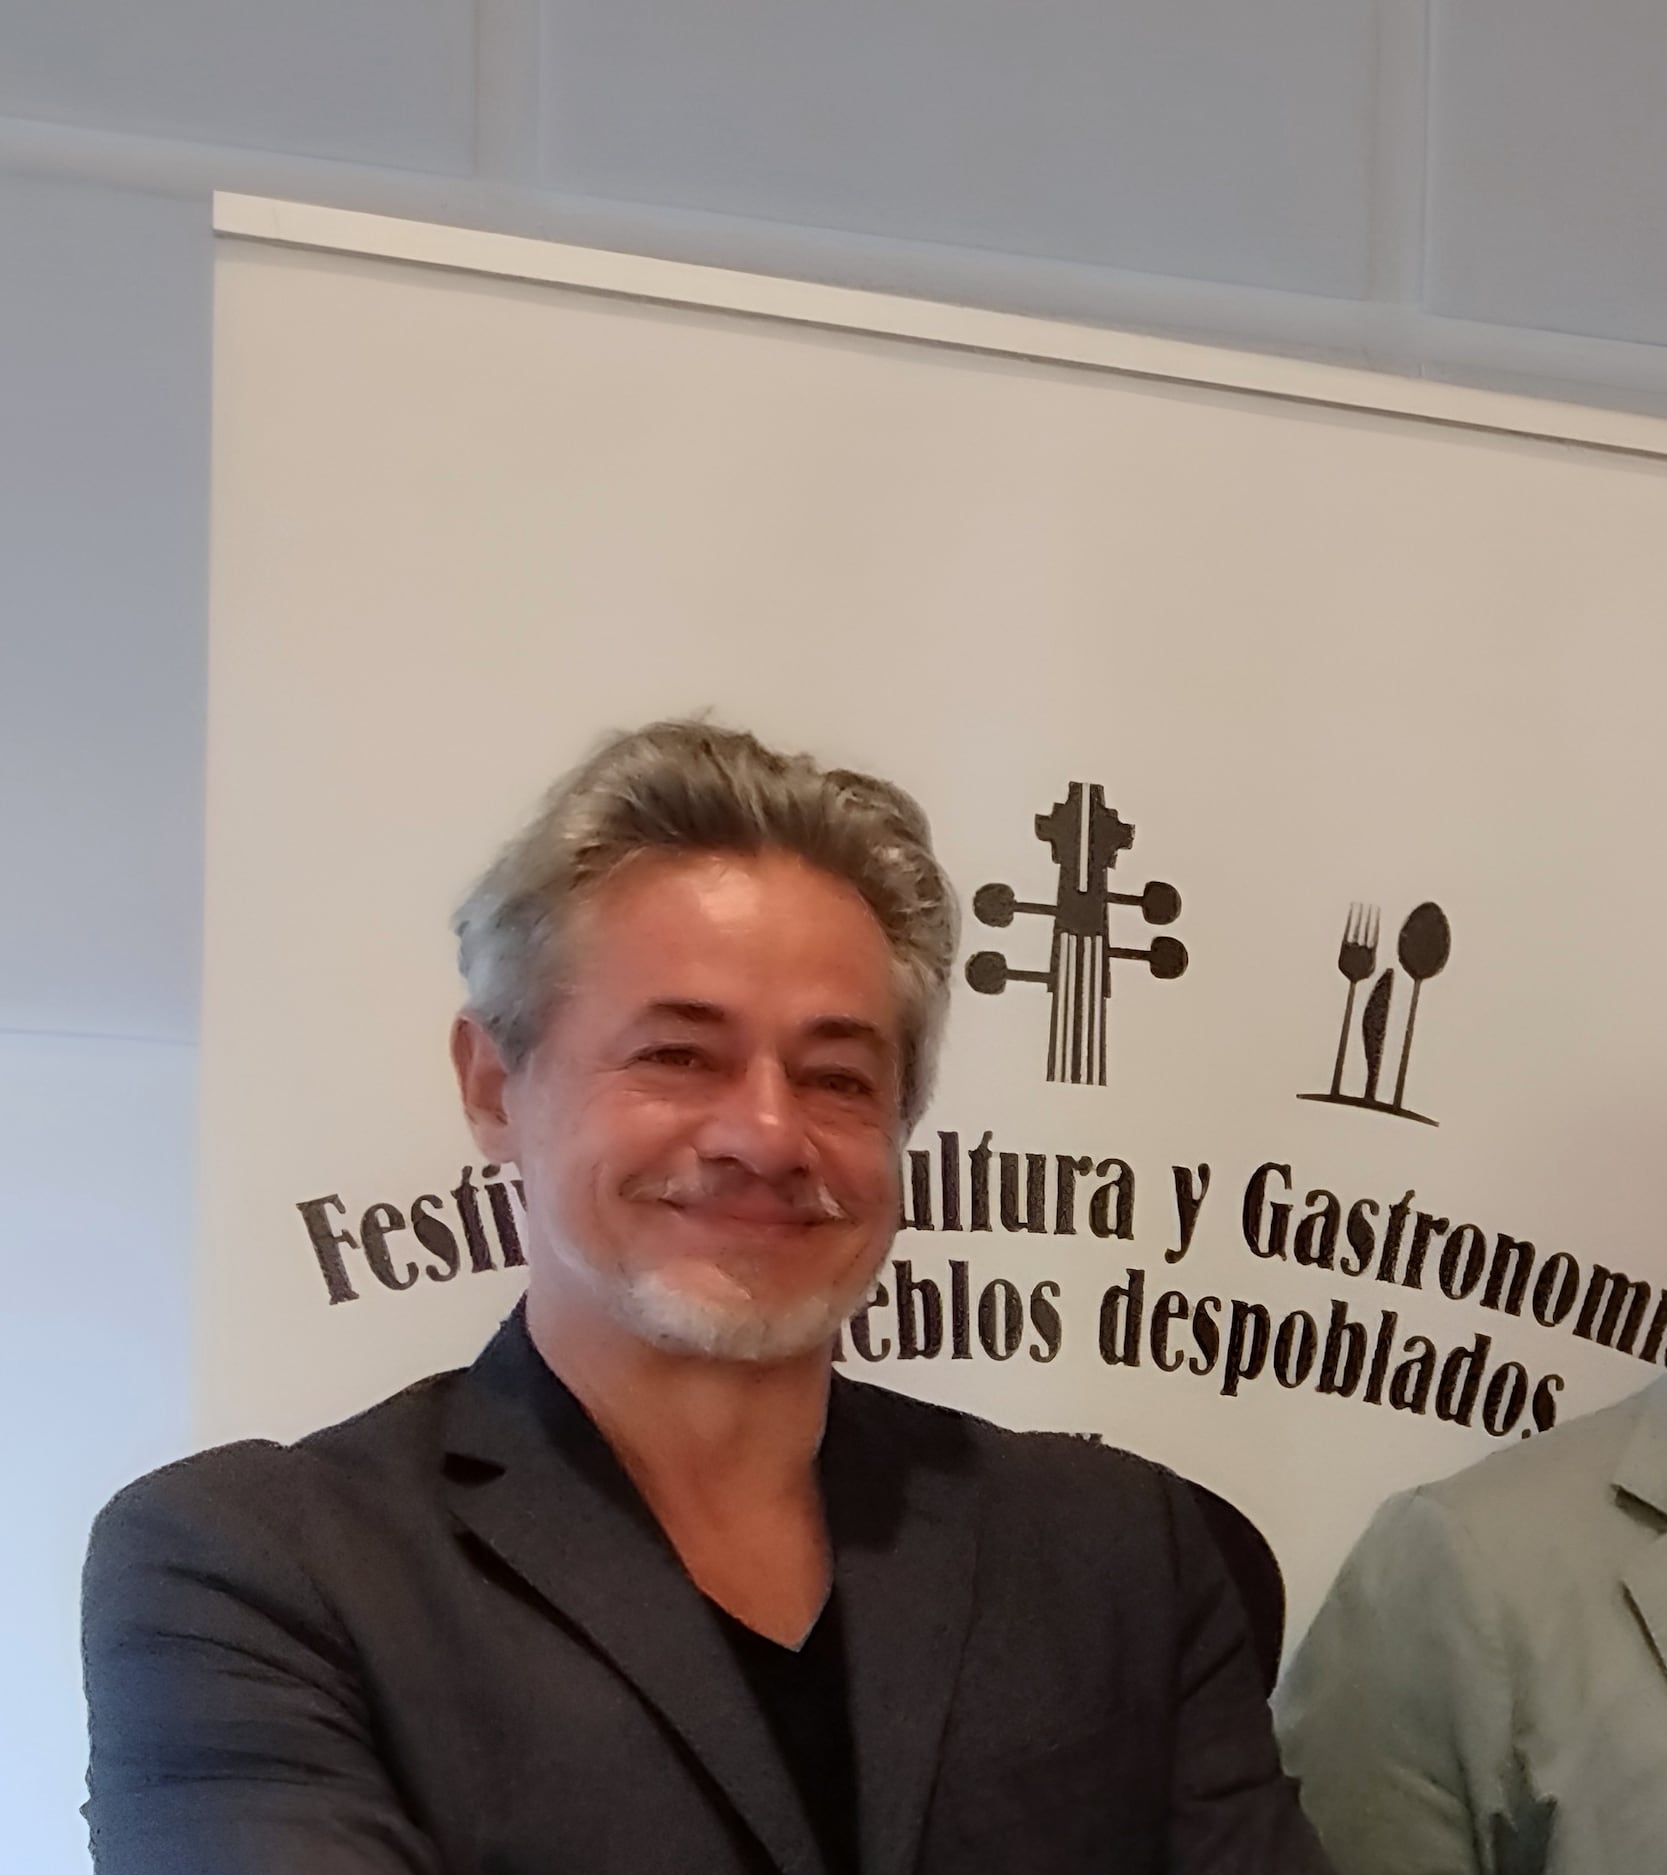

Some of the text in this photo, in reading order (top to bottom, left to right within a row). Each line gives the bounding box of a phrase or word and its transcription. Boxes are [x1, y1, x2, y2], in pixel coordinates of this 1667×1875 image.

[294, 1163, 529, 1307] Festi
[899, 1130, 1134, 1241] ultura
[1164, 1161, 1211, 1265] y
[833, 1259, 1565, 1441] eblos despoblados
